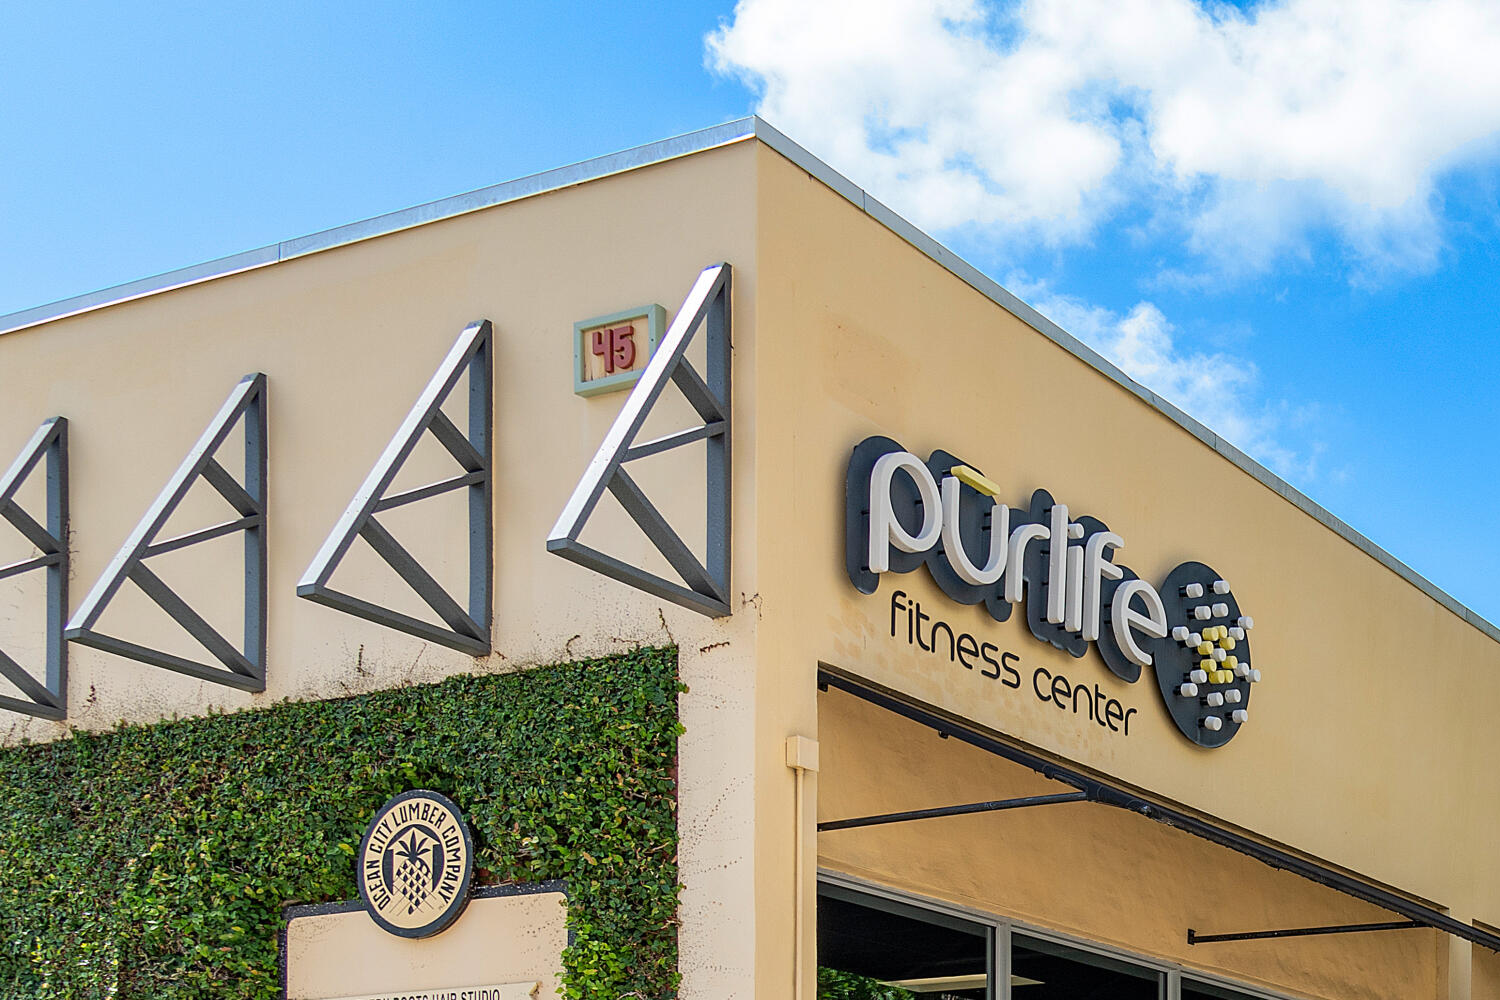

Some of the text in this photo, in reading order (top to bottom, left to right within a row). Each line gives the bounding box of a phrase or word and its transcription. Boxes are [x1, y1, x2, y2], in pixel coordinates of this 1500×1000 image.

[592, 325, 636, 373] 45
[890, 590, 1138, 737] fitness center
[366, 802, 461, 911] OCEAN CITY LUMBER COMPANY
